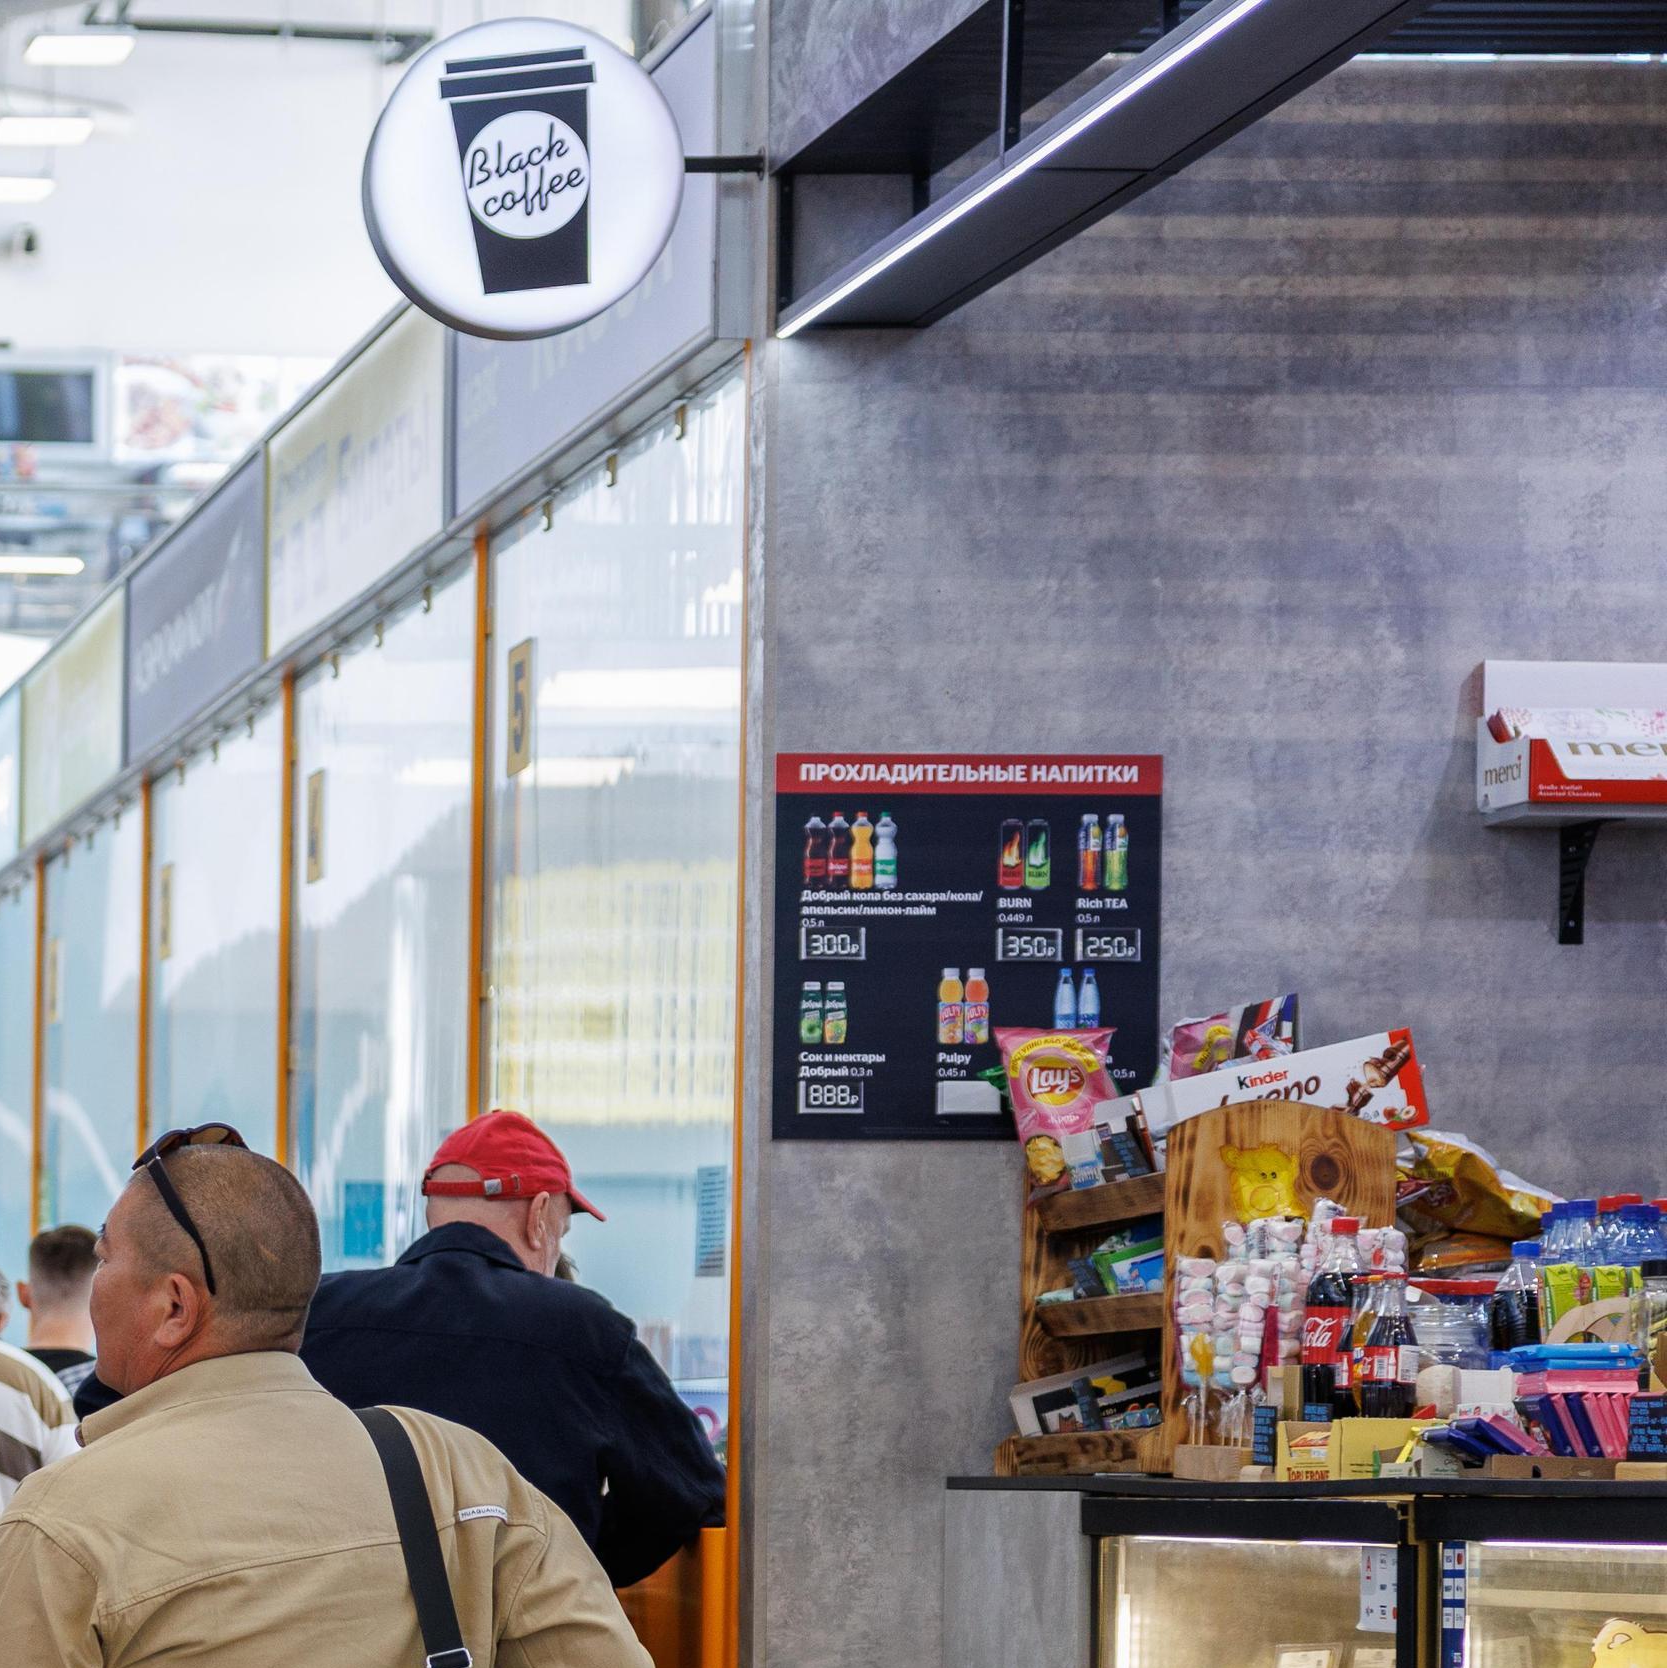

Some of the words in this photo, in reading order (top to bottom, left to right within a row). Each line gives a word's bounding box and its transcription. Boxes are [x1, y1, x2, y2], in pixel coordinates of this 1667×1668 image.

[468, 122, 570, 189] Black
[483, 165, 585, 217] coffee
[1567, 742, 1667, 756] me
[800, 763, 1027, 785] ПРОХЛАДИТЕЛЬНЫЕ
[1030, 764, 1139, 783] НАПИТКИ
[1484, 755, 1522, 786] merci
[801, 890, 851, 902] Добрый
[853, 892, 882, 901] кола
[883, 890, 904, 901] без
[905, 891, 984, 903] сахара/кола/
[998, 898, 1032, 908] BURN
[1077, 898, 1102, 908] Rich
[1104, 898, 1128, 908] TEA
[801, 905, 937, 916] апельсин/лимон-лайм
[800, 1052, 822, 1063] Сок
[824, 1054, 833, 1063] и
[835, 1054, 885, 1066] нектары
[938, 1053, 971, 1065] Pulpy
[800, 1066, 849, 1078] Добрый
[1238, 1069, 1289, 1090] Kinder
